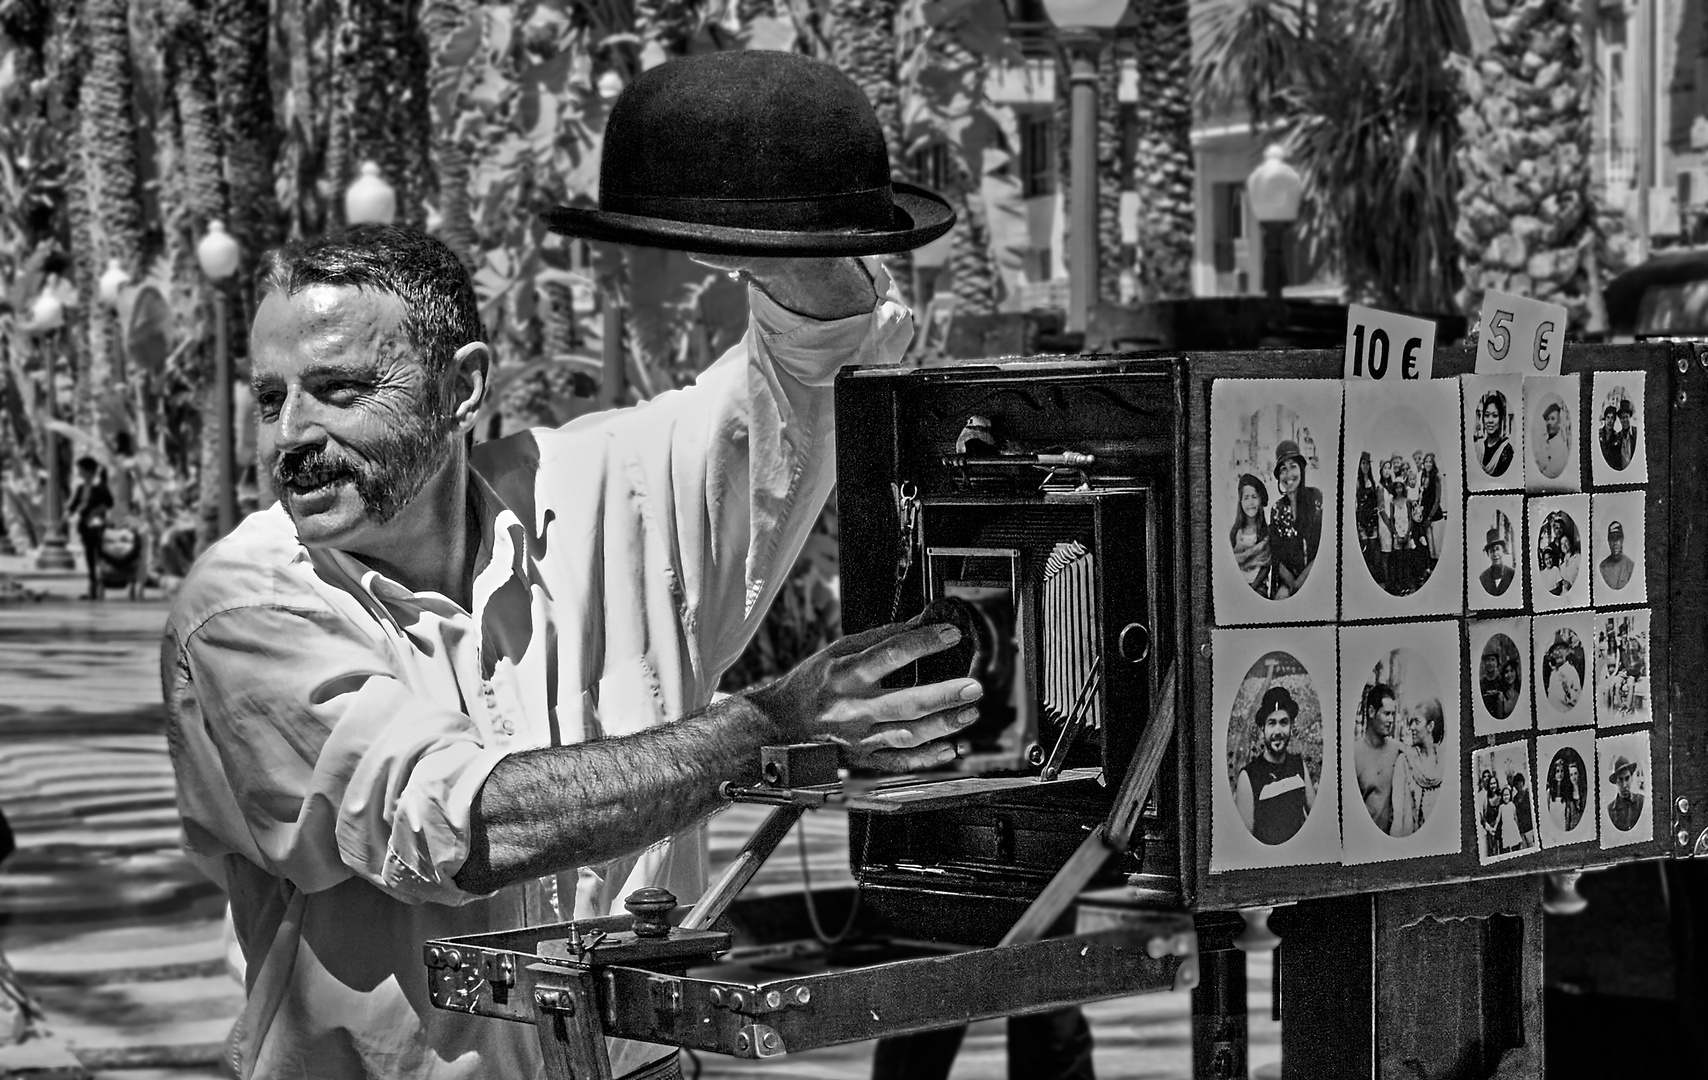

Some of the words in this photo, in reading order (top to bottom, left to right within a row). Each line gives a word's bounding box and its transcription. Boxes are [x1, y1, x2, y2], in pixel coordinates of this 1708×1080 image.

[1352, 324, 1390, 380] 10
[1401, 337, 1422, 380] €
[1487, 309, 1514, 361] 5
[1532, 321, 1555, 371] €
